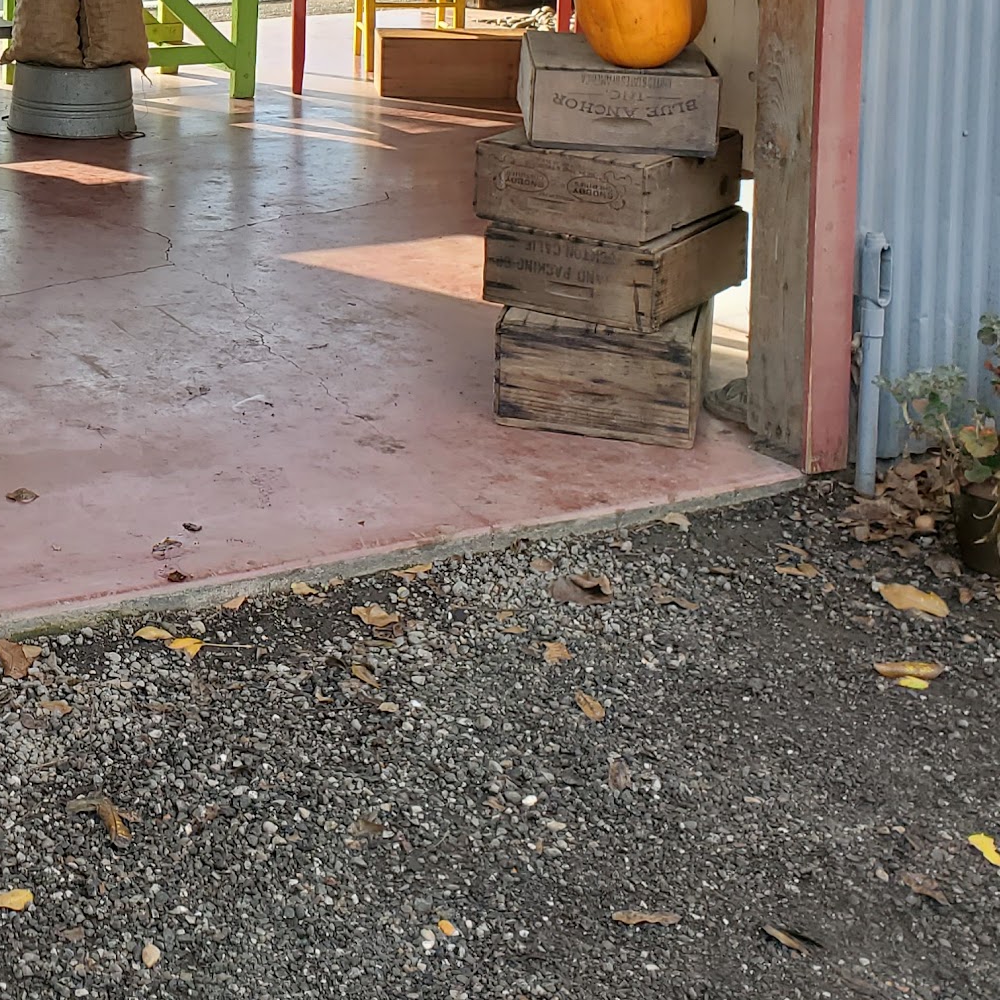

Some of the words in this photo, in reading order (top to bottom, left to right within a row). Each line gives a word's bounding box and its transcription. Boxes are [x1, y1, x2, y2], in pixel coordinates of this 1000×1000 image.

[552, 92, 638, 118] ANCHOR
[646, 98, 698, 118] BLUE
[516, 257, 572, 281] PACKING
